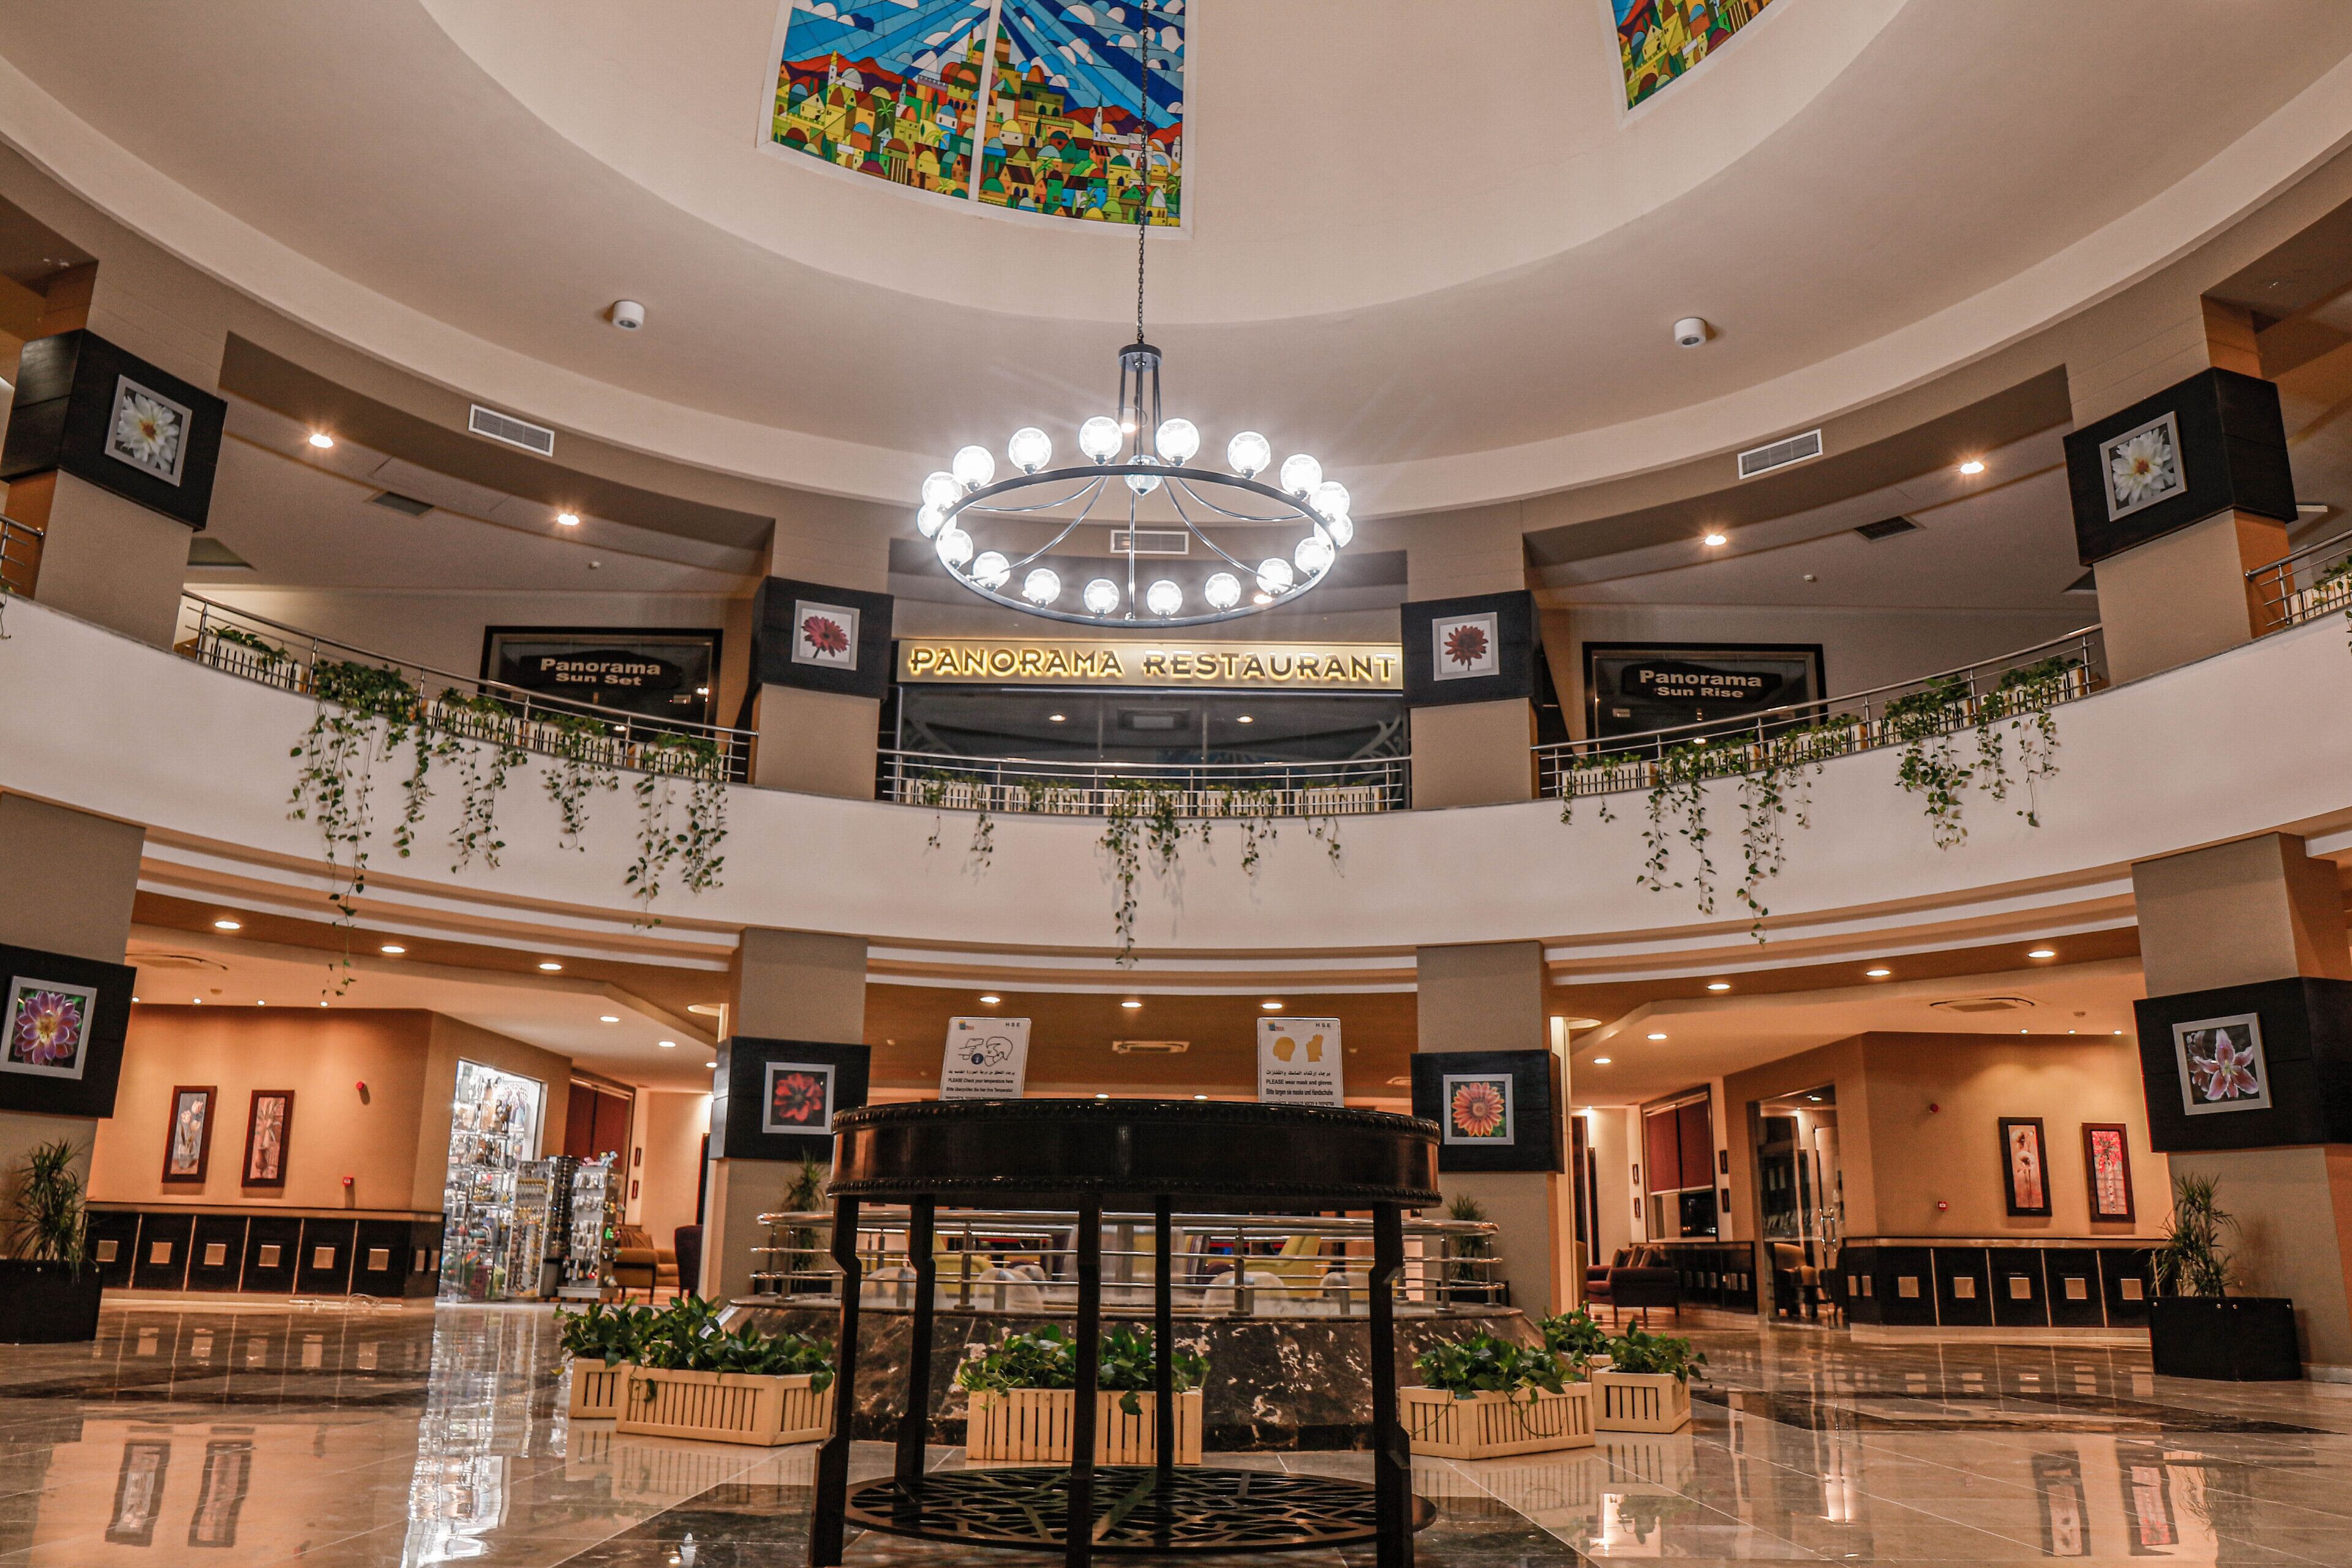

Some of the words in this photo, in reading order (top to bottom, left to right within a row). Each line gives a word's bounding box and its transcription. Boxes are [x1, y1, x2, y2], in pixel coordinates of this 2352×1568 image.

[540, 658, 661, 676] Panorama
[909, 647, 1125, 677] PANORAMA
[1142, 649, 1396, 682] RESTAURANT
[556, 673, 597, 683] Sun
[604, 674, 643, 686] Set
[1639, 669, 1763, 687] Panorama
[1656, 687, 1694, 696] Sun
[1701, 687, 1744, 698] Rise
